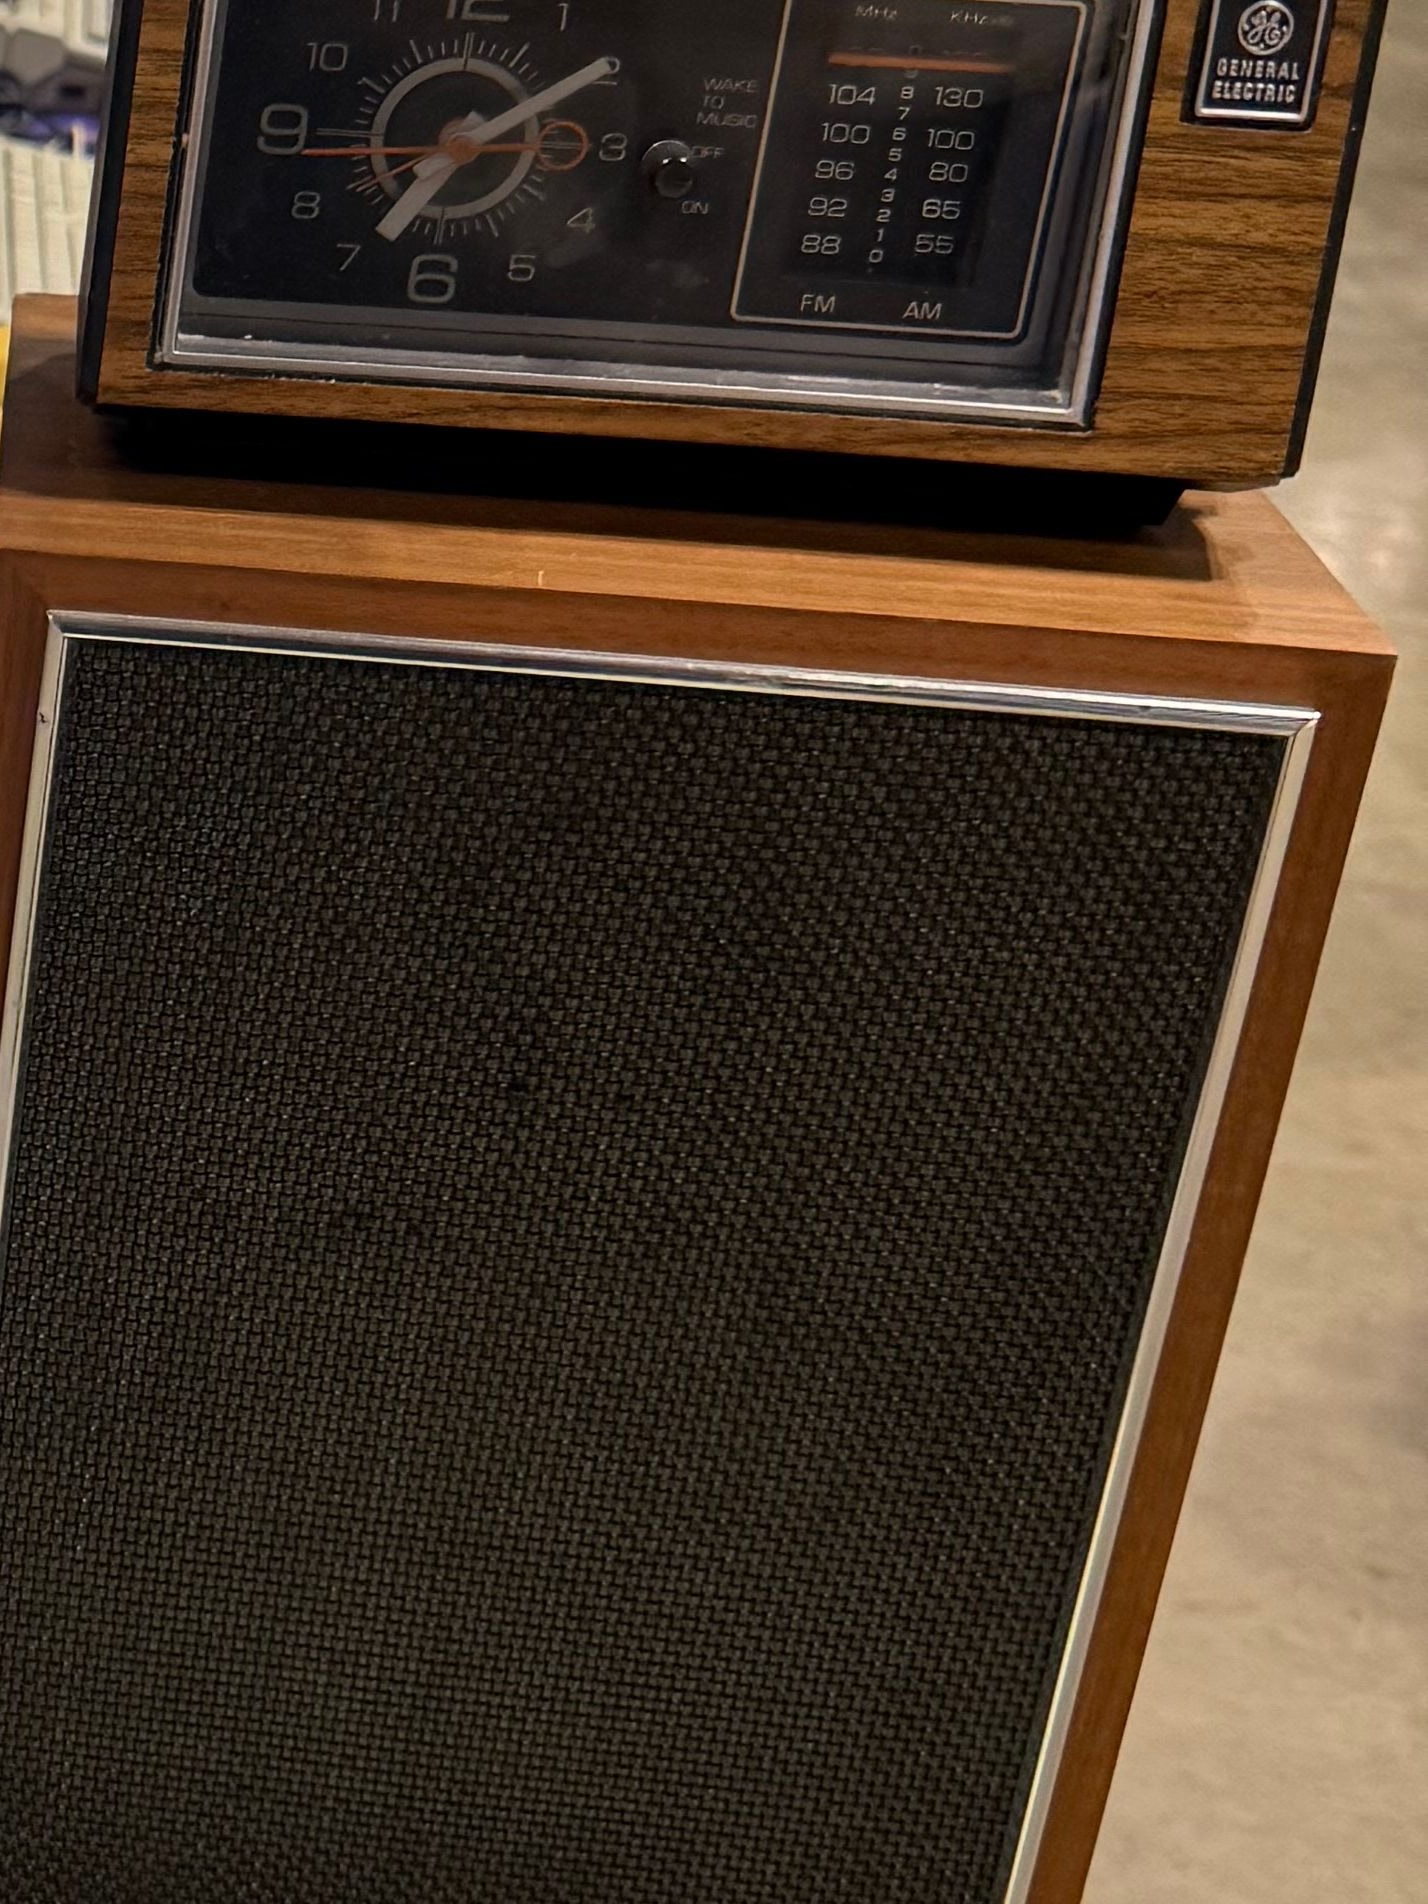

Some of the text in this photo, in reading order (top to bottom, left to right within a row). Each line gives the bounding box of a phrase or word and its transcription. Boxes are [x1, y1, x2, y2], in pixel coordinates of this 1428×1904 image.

[307, 41, 348, 72] 10
[1216, 57, 1300, 81] GENERAL
[703, 78, 759, 94] WAKE
[828, 83, 984, 109] 104 130
[1211, 80, 1296, 104] ELECTRIC
[257, 103, 309, 156] 9
[695, 111, 758, 128] MUSIC
[598, 132, 628, 162] 3
[821, 122, 975, 150] 100 100
[814, 159, 969, 183] 96 80
[291, 191, 322, 220] 8
[807, 196, 961, 220] 92 65
[800, 233, 954, 255] 88 55
[406, 253, 459, 305] 6
[507, 253, 537, 283] 5
[800, 293, 943, 320] FM AM
